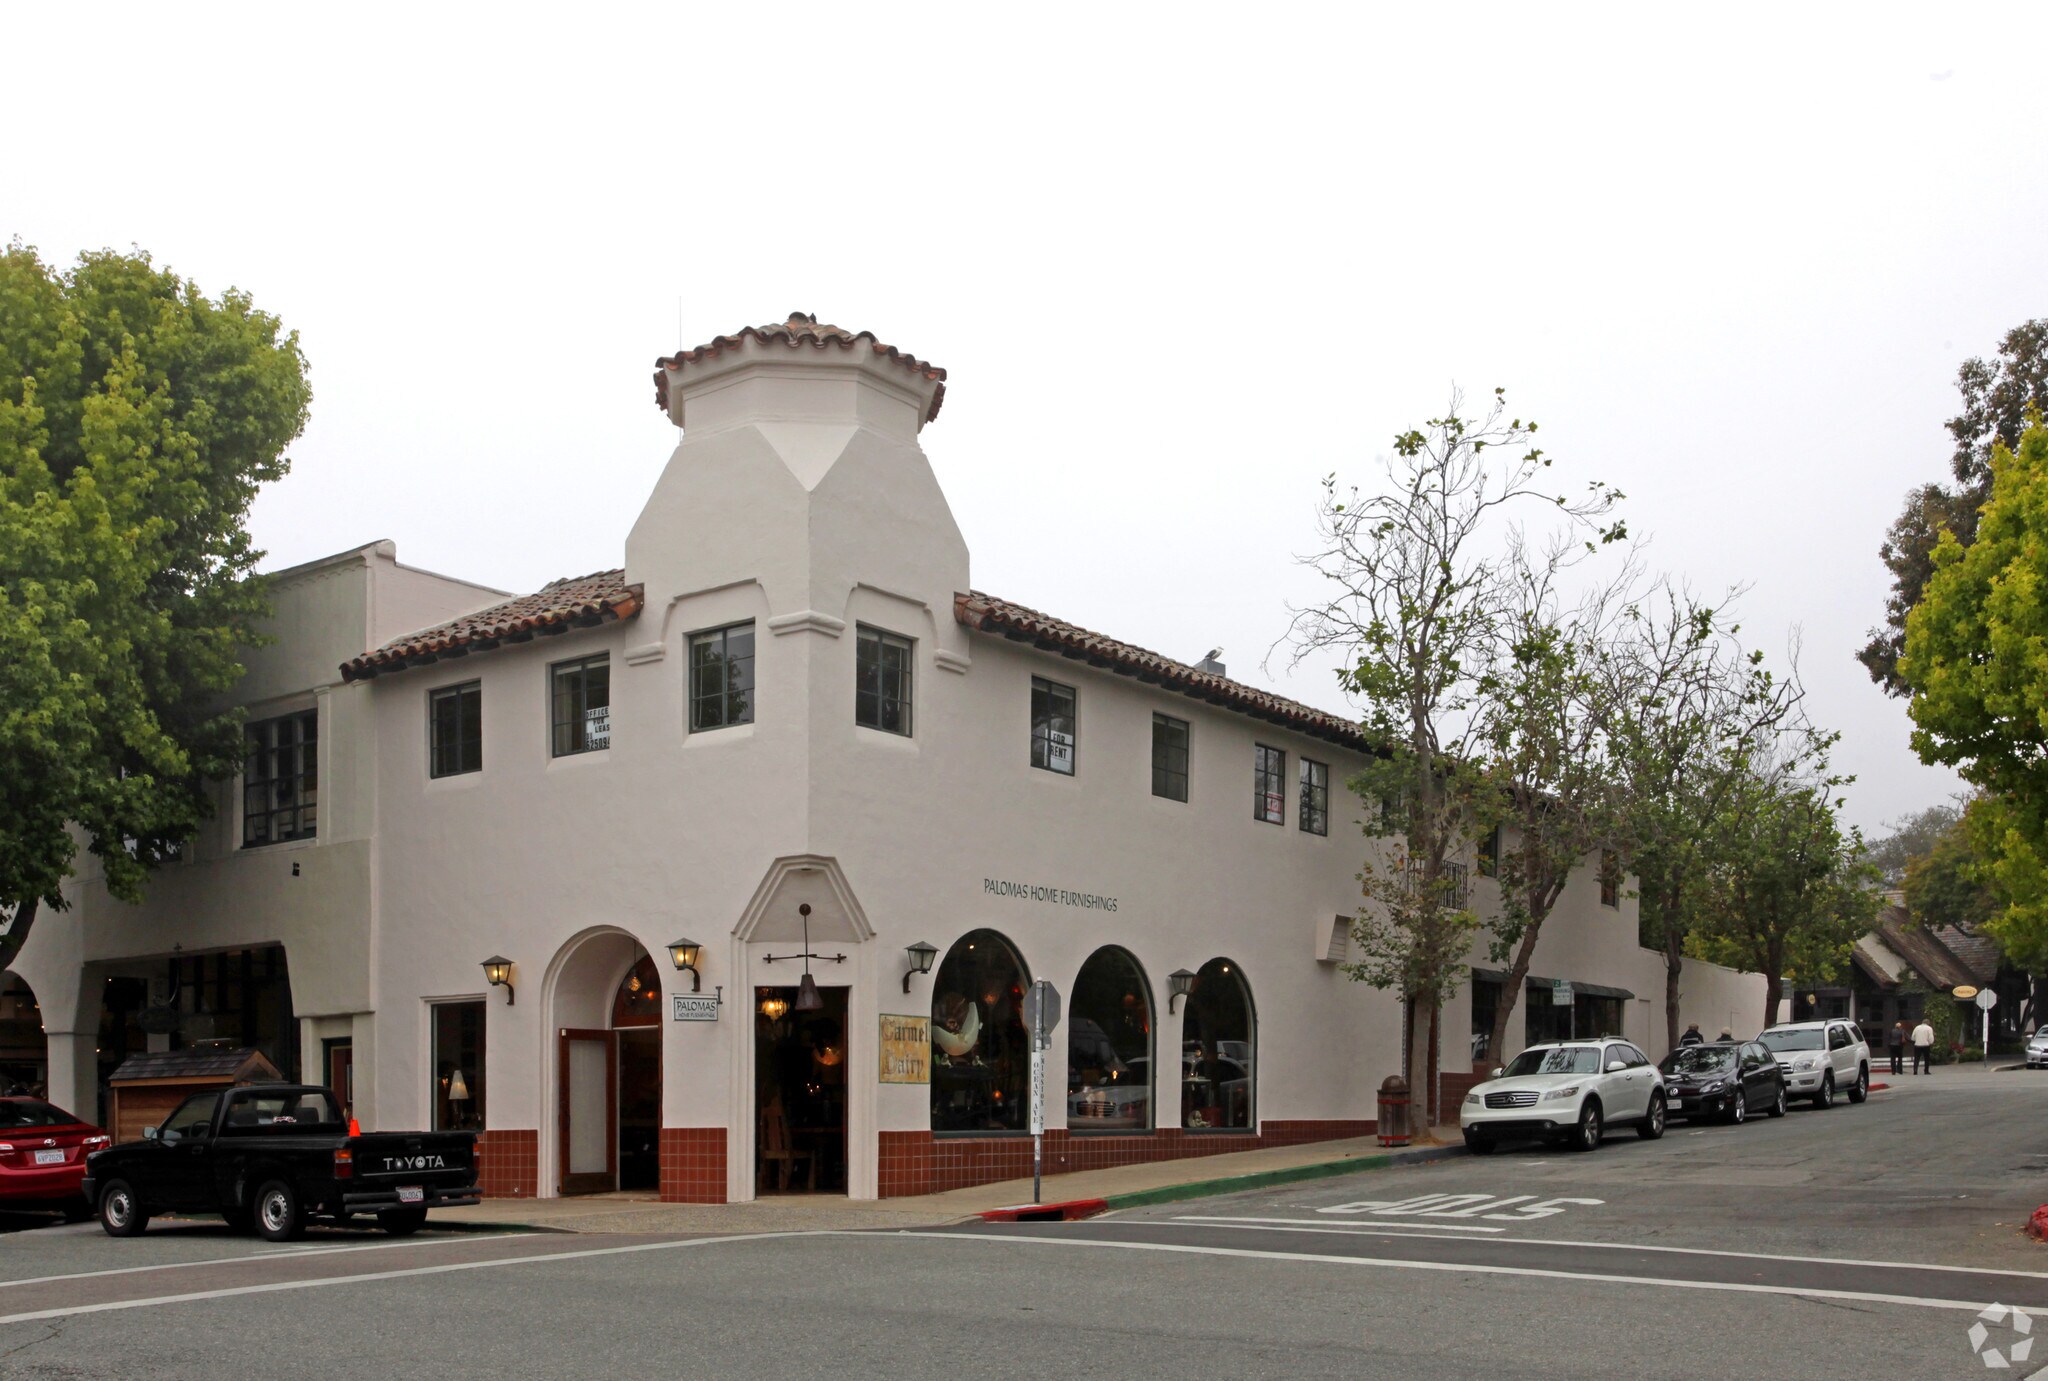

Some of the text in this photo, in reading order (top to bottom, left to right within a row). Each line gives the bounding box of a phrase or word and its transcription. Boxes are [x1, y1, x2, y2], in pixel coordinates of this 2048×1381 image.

[586, 707, 609, 719] OFFICE
[595, 724, 610, 733] LEAS
[1053, 733, 1066, 744] FOR
[1050, 745, 1067, 759] RENT
[984, 878, 1118, 912] PALOMAS HOME FURNISHINGS
[676, 1001, 716, 1012] PALOMAS
[882, 1016, 929, 1044] Carmel
[882, 1049, 924, 1081] Dairy
[383, 1155, 445, 1170] TOYOTA
[1315, 1193, 1605, 1220] STOP
